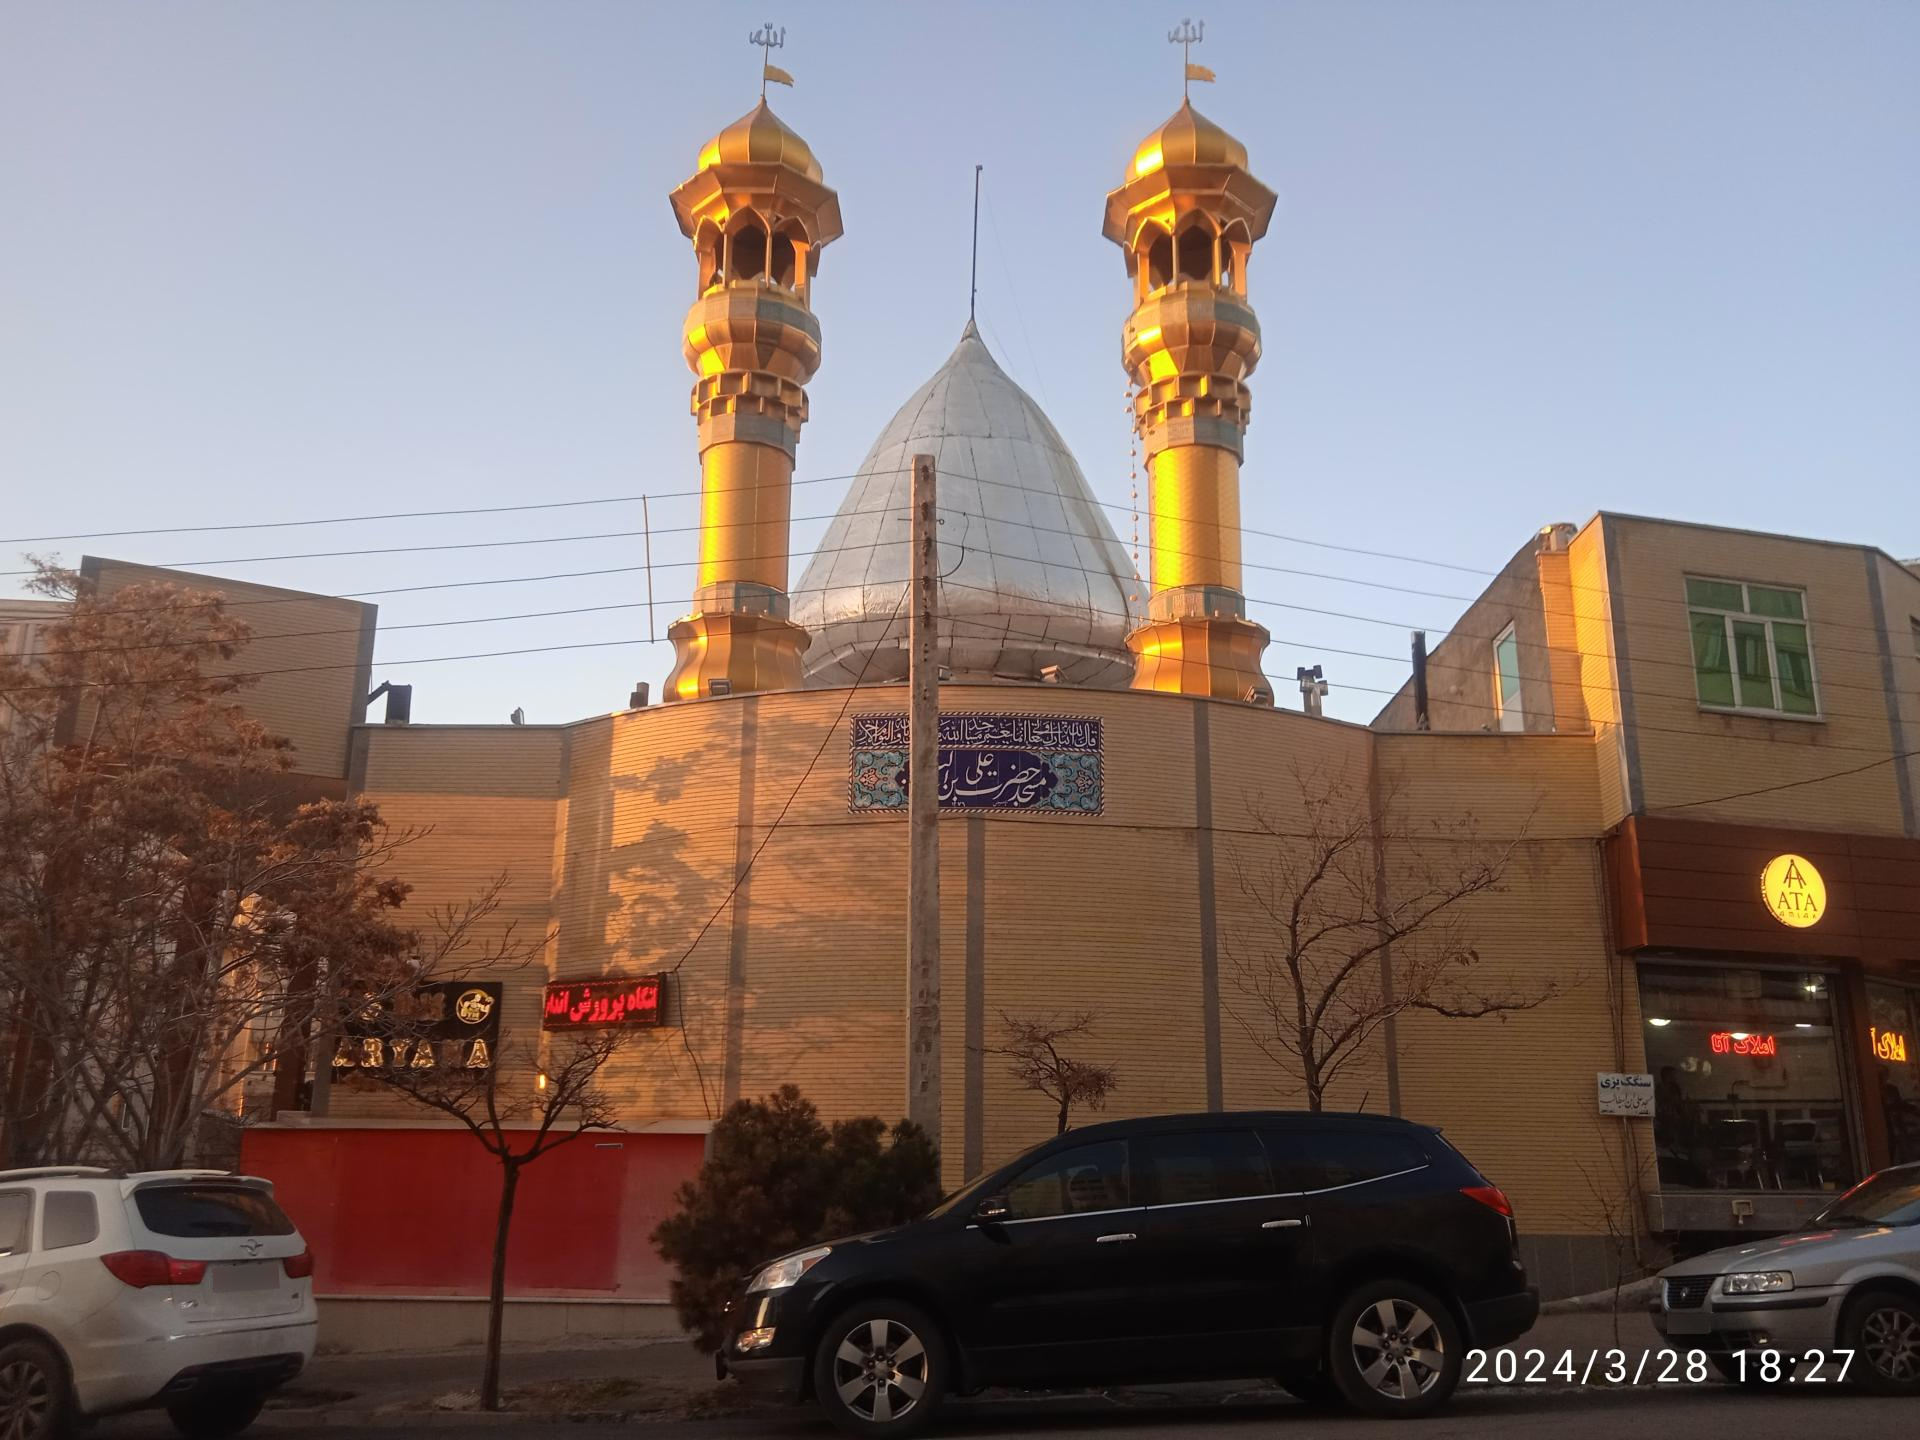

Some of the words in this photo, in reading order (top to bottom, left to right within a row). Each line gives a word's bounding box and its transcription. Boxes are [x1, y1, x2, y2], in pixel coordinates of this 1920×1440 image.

[749, 22, 787, 48] الله
[1167, 17, 1205, 43] الله
[955, 764, 1041, 801] حضرت
[965, 751, 994, 785] علی
[1008, 776, 1047, 807] مسجد
[1777, 891, 1818, 912] ATA
[570, 988, 625, 1022] پرورش
[331, 1038, 490, 1069] ARYAA
[1733, 1035, 1775, 1056] املاک
